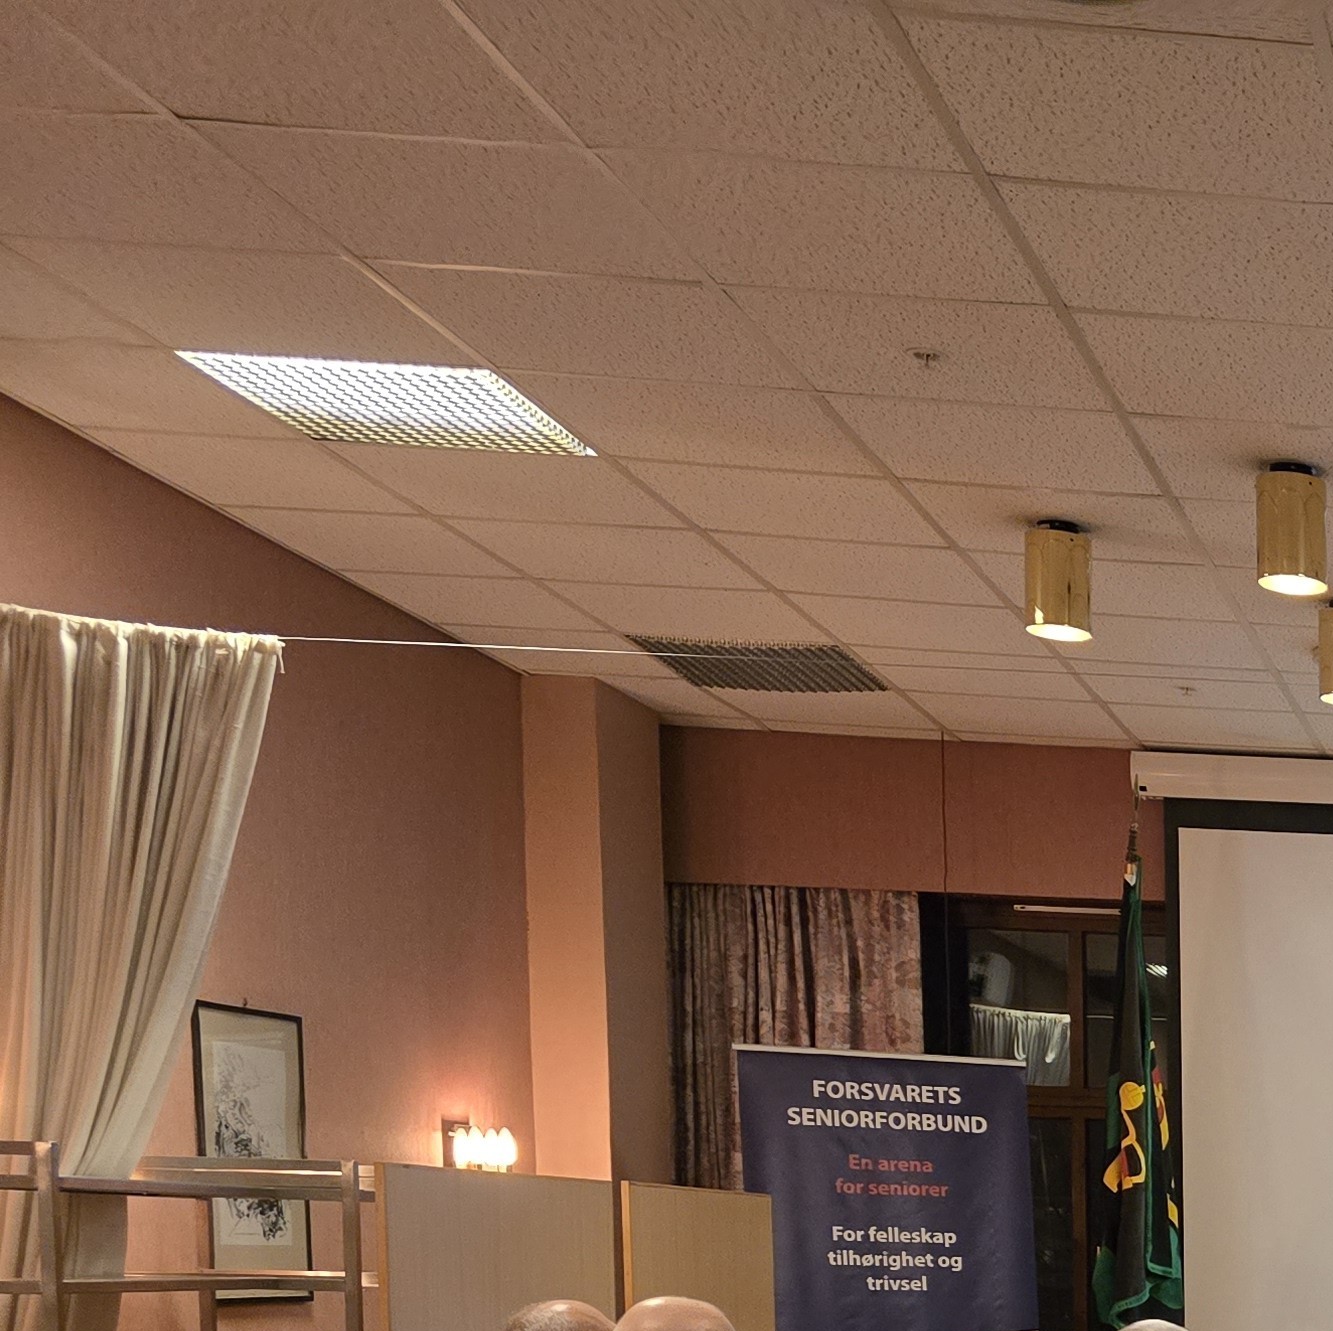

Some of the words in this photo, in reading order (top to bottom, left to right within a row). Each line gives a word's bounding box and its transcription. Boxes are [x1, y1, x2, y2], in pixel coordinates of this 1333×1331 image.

[812, 1079, 962, 1105] FORSVARETS
[787, 1107, 988, 1134] SENIORFORBUND
[848, 1153, 873, 1171] En
[878, 1157, 934, 1173] arena
[835, 1178, 864, 1195] for
[868, 1180, 949, 1197] seniorer
[832, 1226, 865, 1242] For
[868, 1226, 957, 1248] felleskap
[827, 1249, 934, 1271] tilhørighet
[938, 1255, 963, 1272] og
[866, 1274, 928, 1291] trivsel
